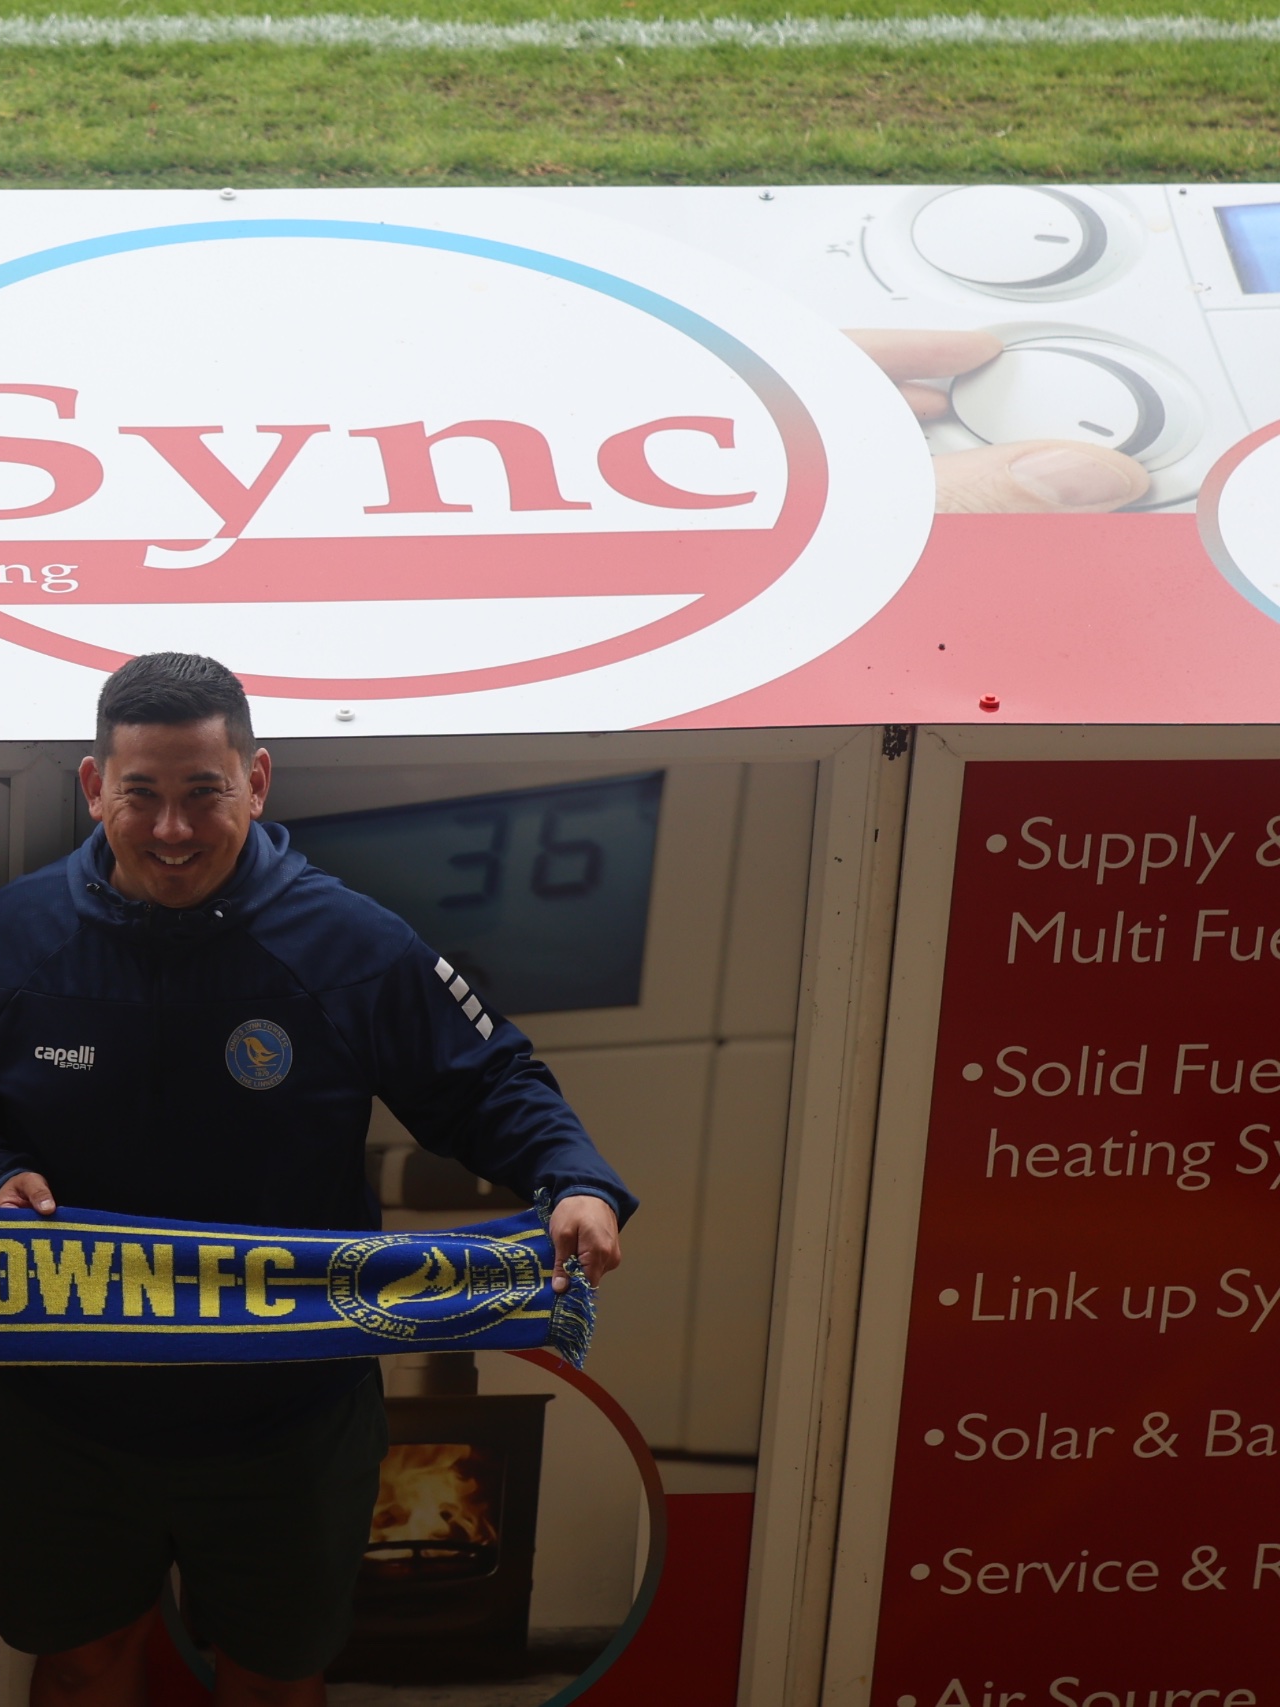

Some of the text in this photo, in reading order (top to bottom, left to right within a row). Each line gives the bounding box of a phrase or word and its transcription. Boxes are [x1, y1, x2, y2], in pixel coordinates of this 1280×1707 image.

[438, 797, 608, 908] 36
[1017, 815, 1236, 885] Supply
[1007, 910, 1168, 964] Multi
[34, 1045, 96, 1066] capelli
[59, 1061, 94, 1071] SPORT
[993, 1043, 1280, 1097] Solid Fue
[986, 1128, 1216, 1191] heating
[198, 1244, 297, 1318] FC
[971, 1271, 1100, 1322] Link
[1122, 1285, 1197, 1334] up
[954, 1409, 1278, 1461] Solar & Ba
[939, 1547, 1160, 1595] Service
[1181, 1544, 1228, 1591] &
